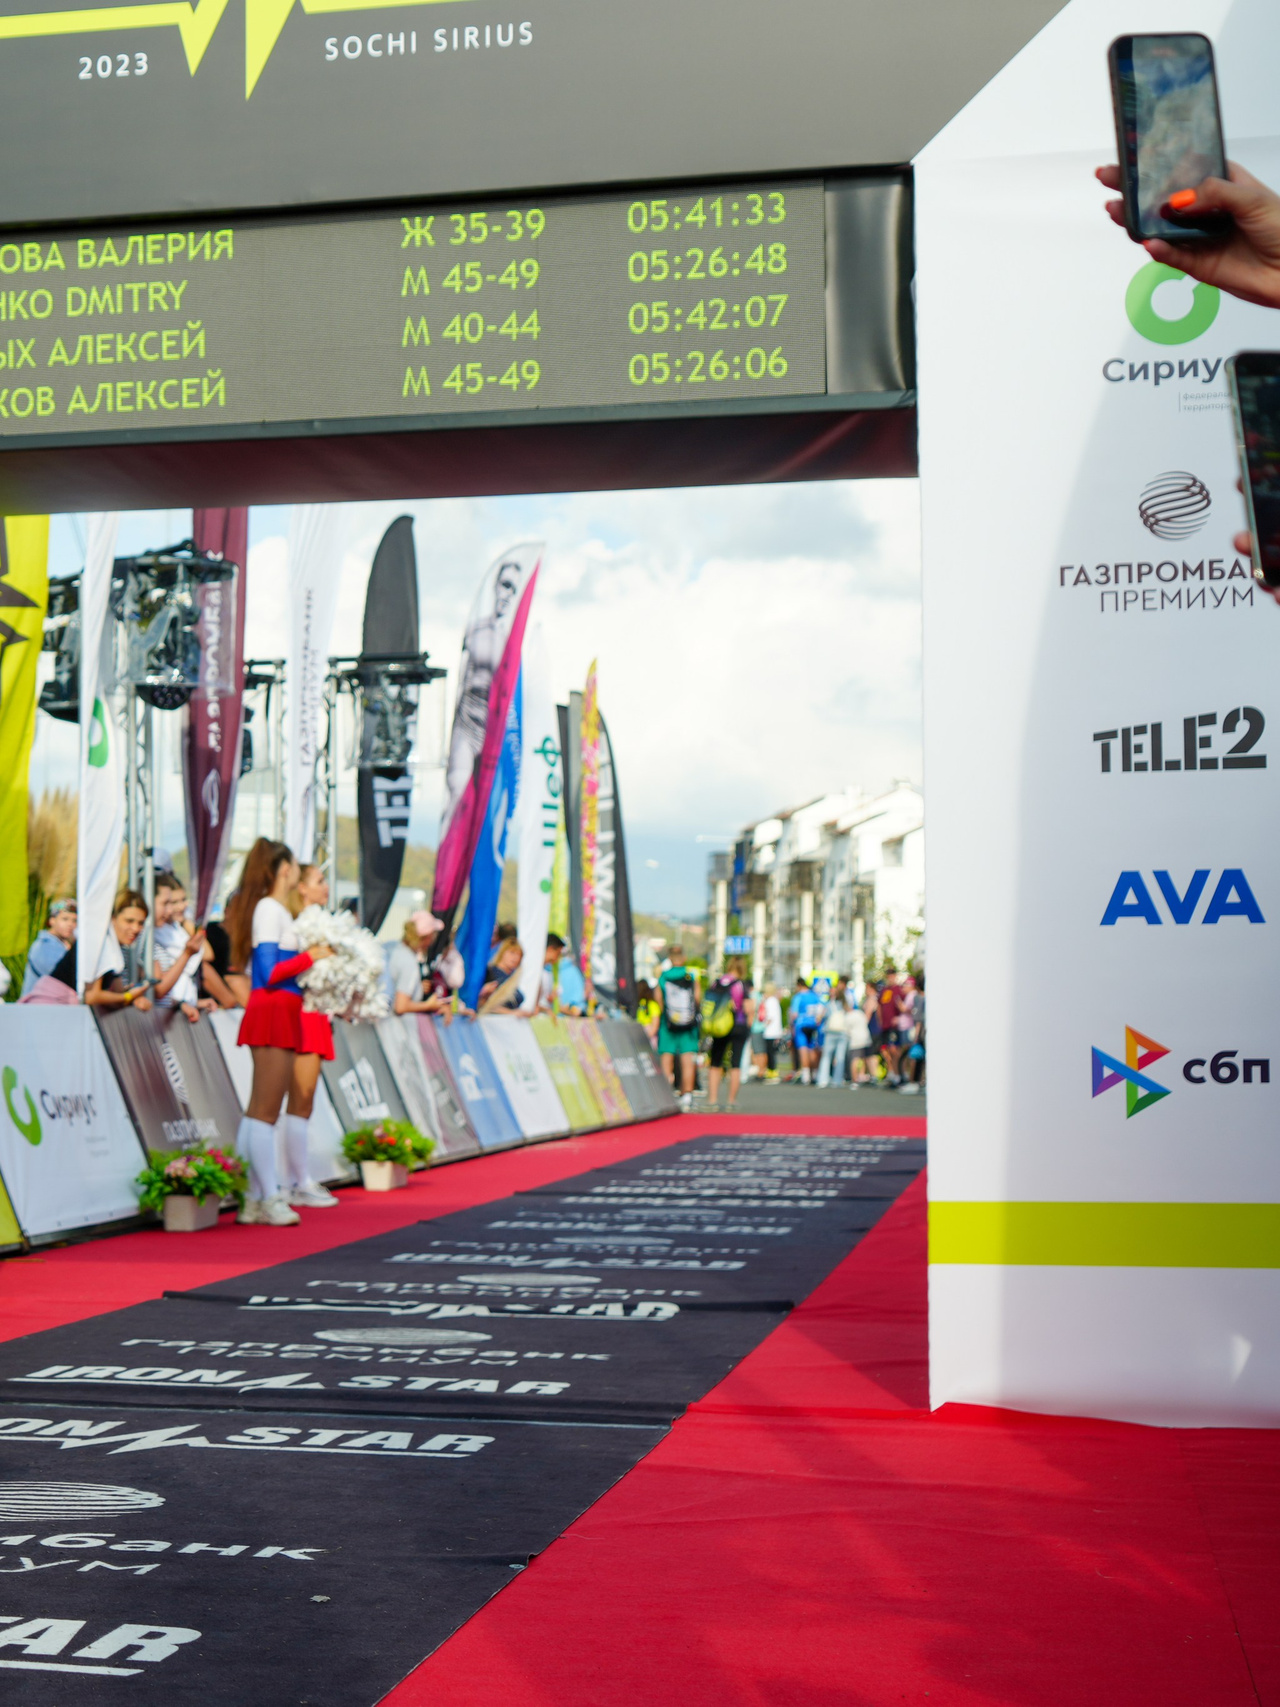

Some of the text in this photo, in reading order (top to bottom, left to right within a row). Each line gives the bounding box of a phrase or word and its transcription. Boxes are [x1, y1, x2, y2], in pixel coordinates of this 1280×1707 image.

[78, 21, 534, 80] 2023 SOCHI SIRIUS
[77, 228, 235, 269] ВАЛЕРИЯ
[401, 216, 435, 248] Ж
[448, 208, 546, 246] 35-39
[627, 192, 787, 233] 05:41:33
[65, 280, 188, 317] DMITRY
[441, 257, 540, 294] 45-49
[627, 243, 788, 283] 05:26:48
[47, 319, 207, 367] АЛЕКСЕЙ
[441, 308, 541, 344] 40-44
[627, 294, 789, 335] 05:42:07
[66, 368, 226, 415] АЛЕКСЕЙ
[441, 359, 541, 395] 45-49
[627, 346, 789, 385] 05:26:06
[1100, 585, 1254, 613] ПРЕМИУМ
[1093, 706, 1268, 773] TELE2
[1099, 868, 1267, 926] AVA
[1182, 1050, 1271, 1085] сбп
[26, 1365, 572, 1395] IRON STAR
[226, 1426, 495, 1454] STAR
